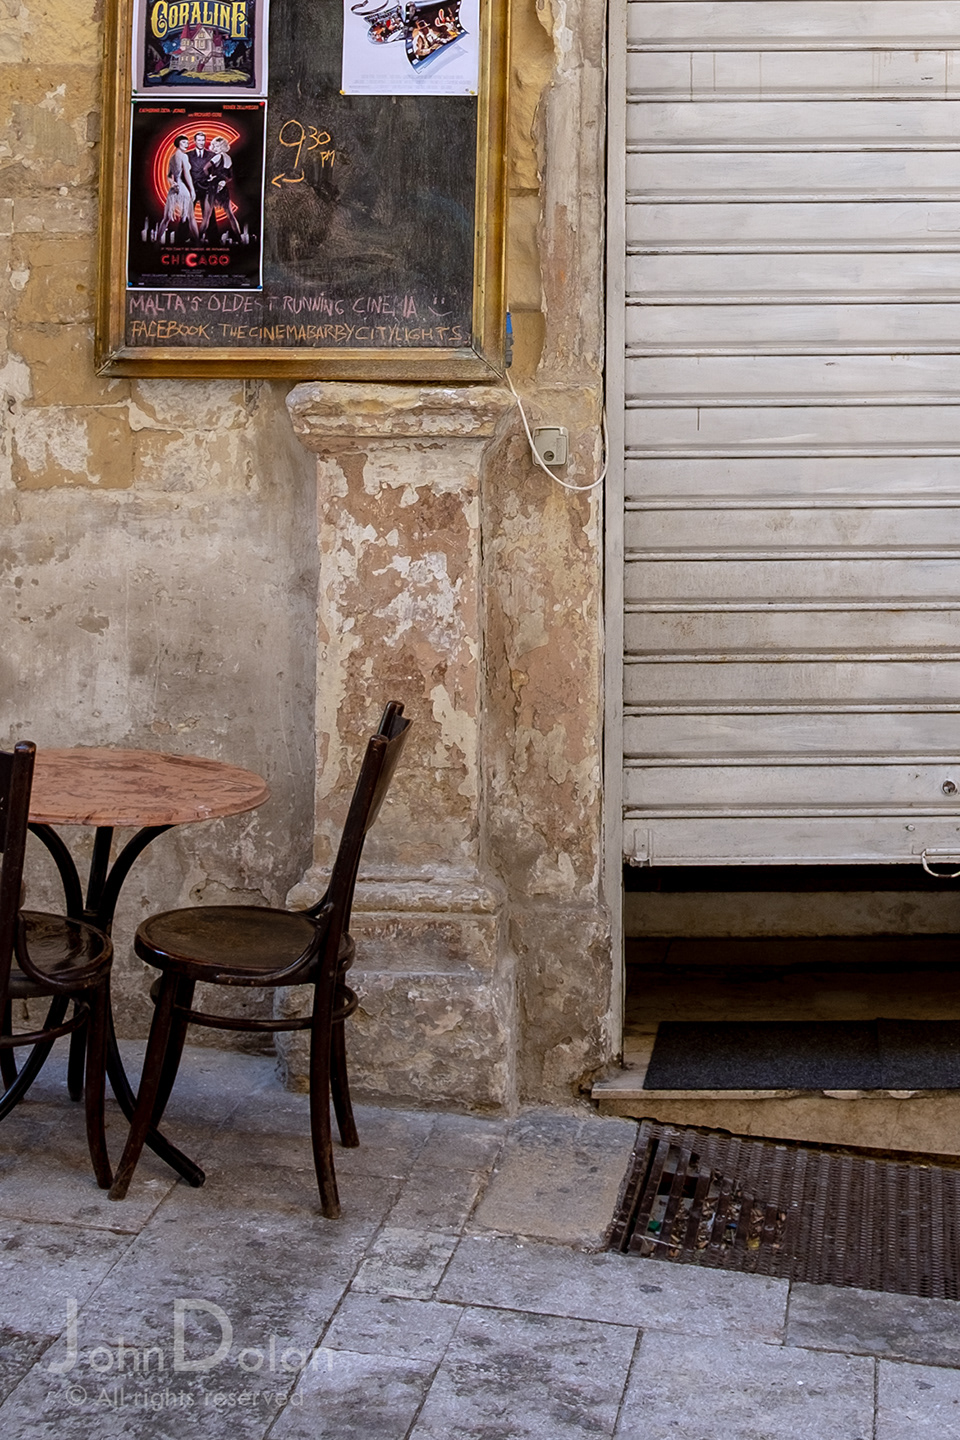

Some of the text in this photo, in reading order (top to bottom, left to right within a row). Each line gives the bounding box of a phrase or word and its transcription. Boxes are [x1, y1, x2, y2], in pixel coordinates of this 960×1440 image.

[150, 0, 249, 39] CORALINE
[320, 150, 336, 168] PM
[161, 252, 230, 268] CHICAGO
[129, 293, 202, 316] MALTA'S
